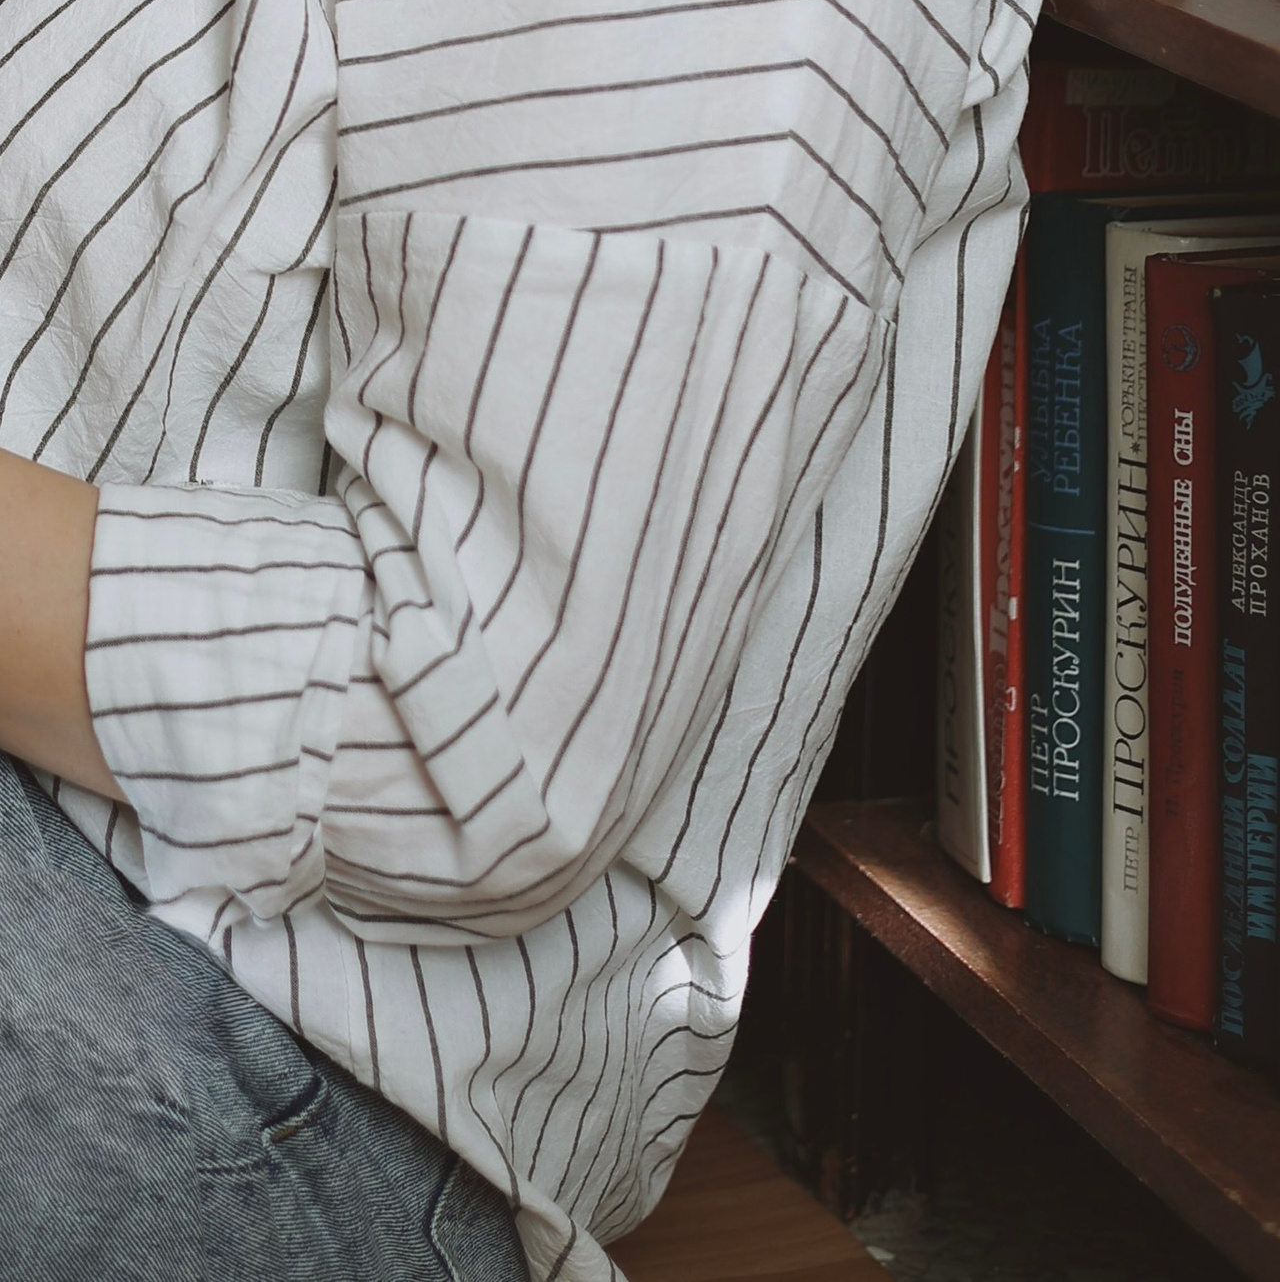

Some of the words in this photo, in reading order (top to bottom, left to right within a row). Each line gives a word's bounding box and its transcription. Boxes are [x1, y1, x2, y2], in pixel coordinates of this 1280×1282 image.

[1122, 264, 1138, 335] ТРАВЫ
[1030, 317, 1052, 483] УЛЫБКА
[1054, 321, 1082, 498] РЕБЕНКА
[1121, 338, 1136, 439] ГОРЬКИЕ
[1174, 407, 1193, 466] СНЫ
[1174, 478, 1197, 648] ПОЛУДЕННЫЕ
[1231, 469, 1251, 613] АЛЕКСАНДР
[1250, 471, 1271, 617] ПРОХАНОВ
[1052, 556, 1082, 802] ПРОСКУРИН
[1112, 452, 1147, 824] ПРОСКУРИН
[1222, 638, 1247, 786] СОЛДАТ
[1030, 692, 1051, 796] ПЕТР
[1123, 826, 1141, 895] ПЕТР
[1221, 795, 1246, 1039] ПОСЛЕДНИЙ
[1247, 752, 1278, 945] ИМПЕРИИ
